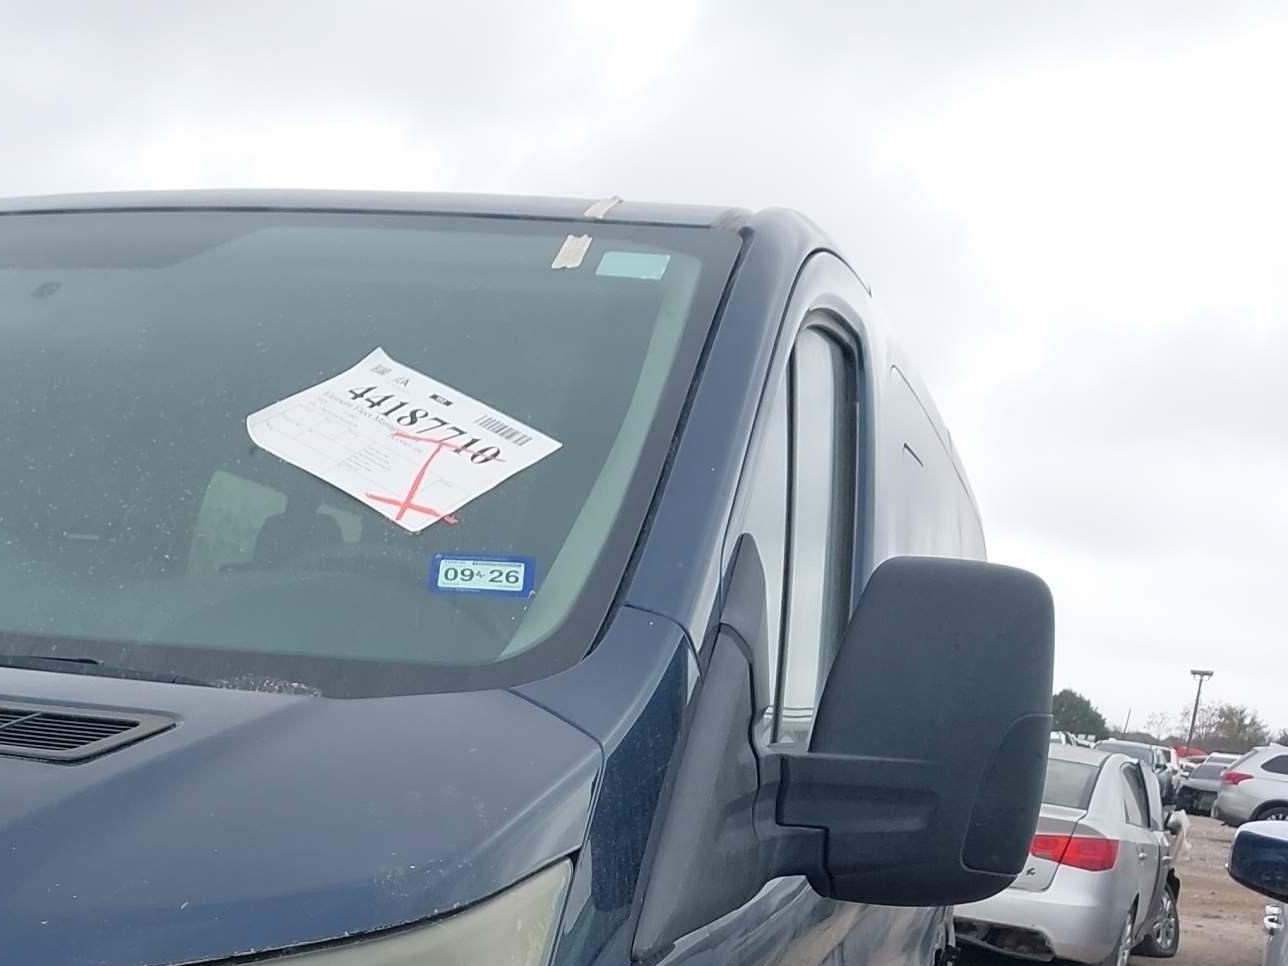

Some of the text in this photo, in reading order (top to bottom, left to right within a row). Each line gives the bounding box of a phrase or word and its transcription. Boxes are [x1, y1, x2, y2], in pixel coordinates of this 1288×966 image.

[348, 385, 501, 464] 44187710
[443, 566, 520, 585] 09 26
